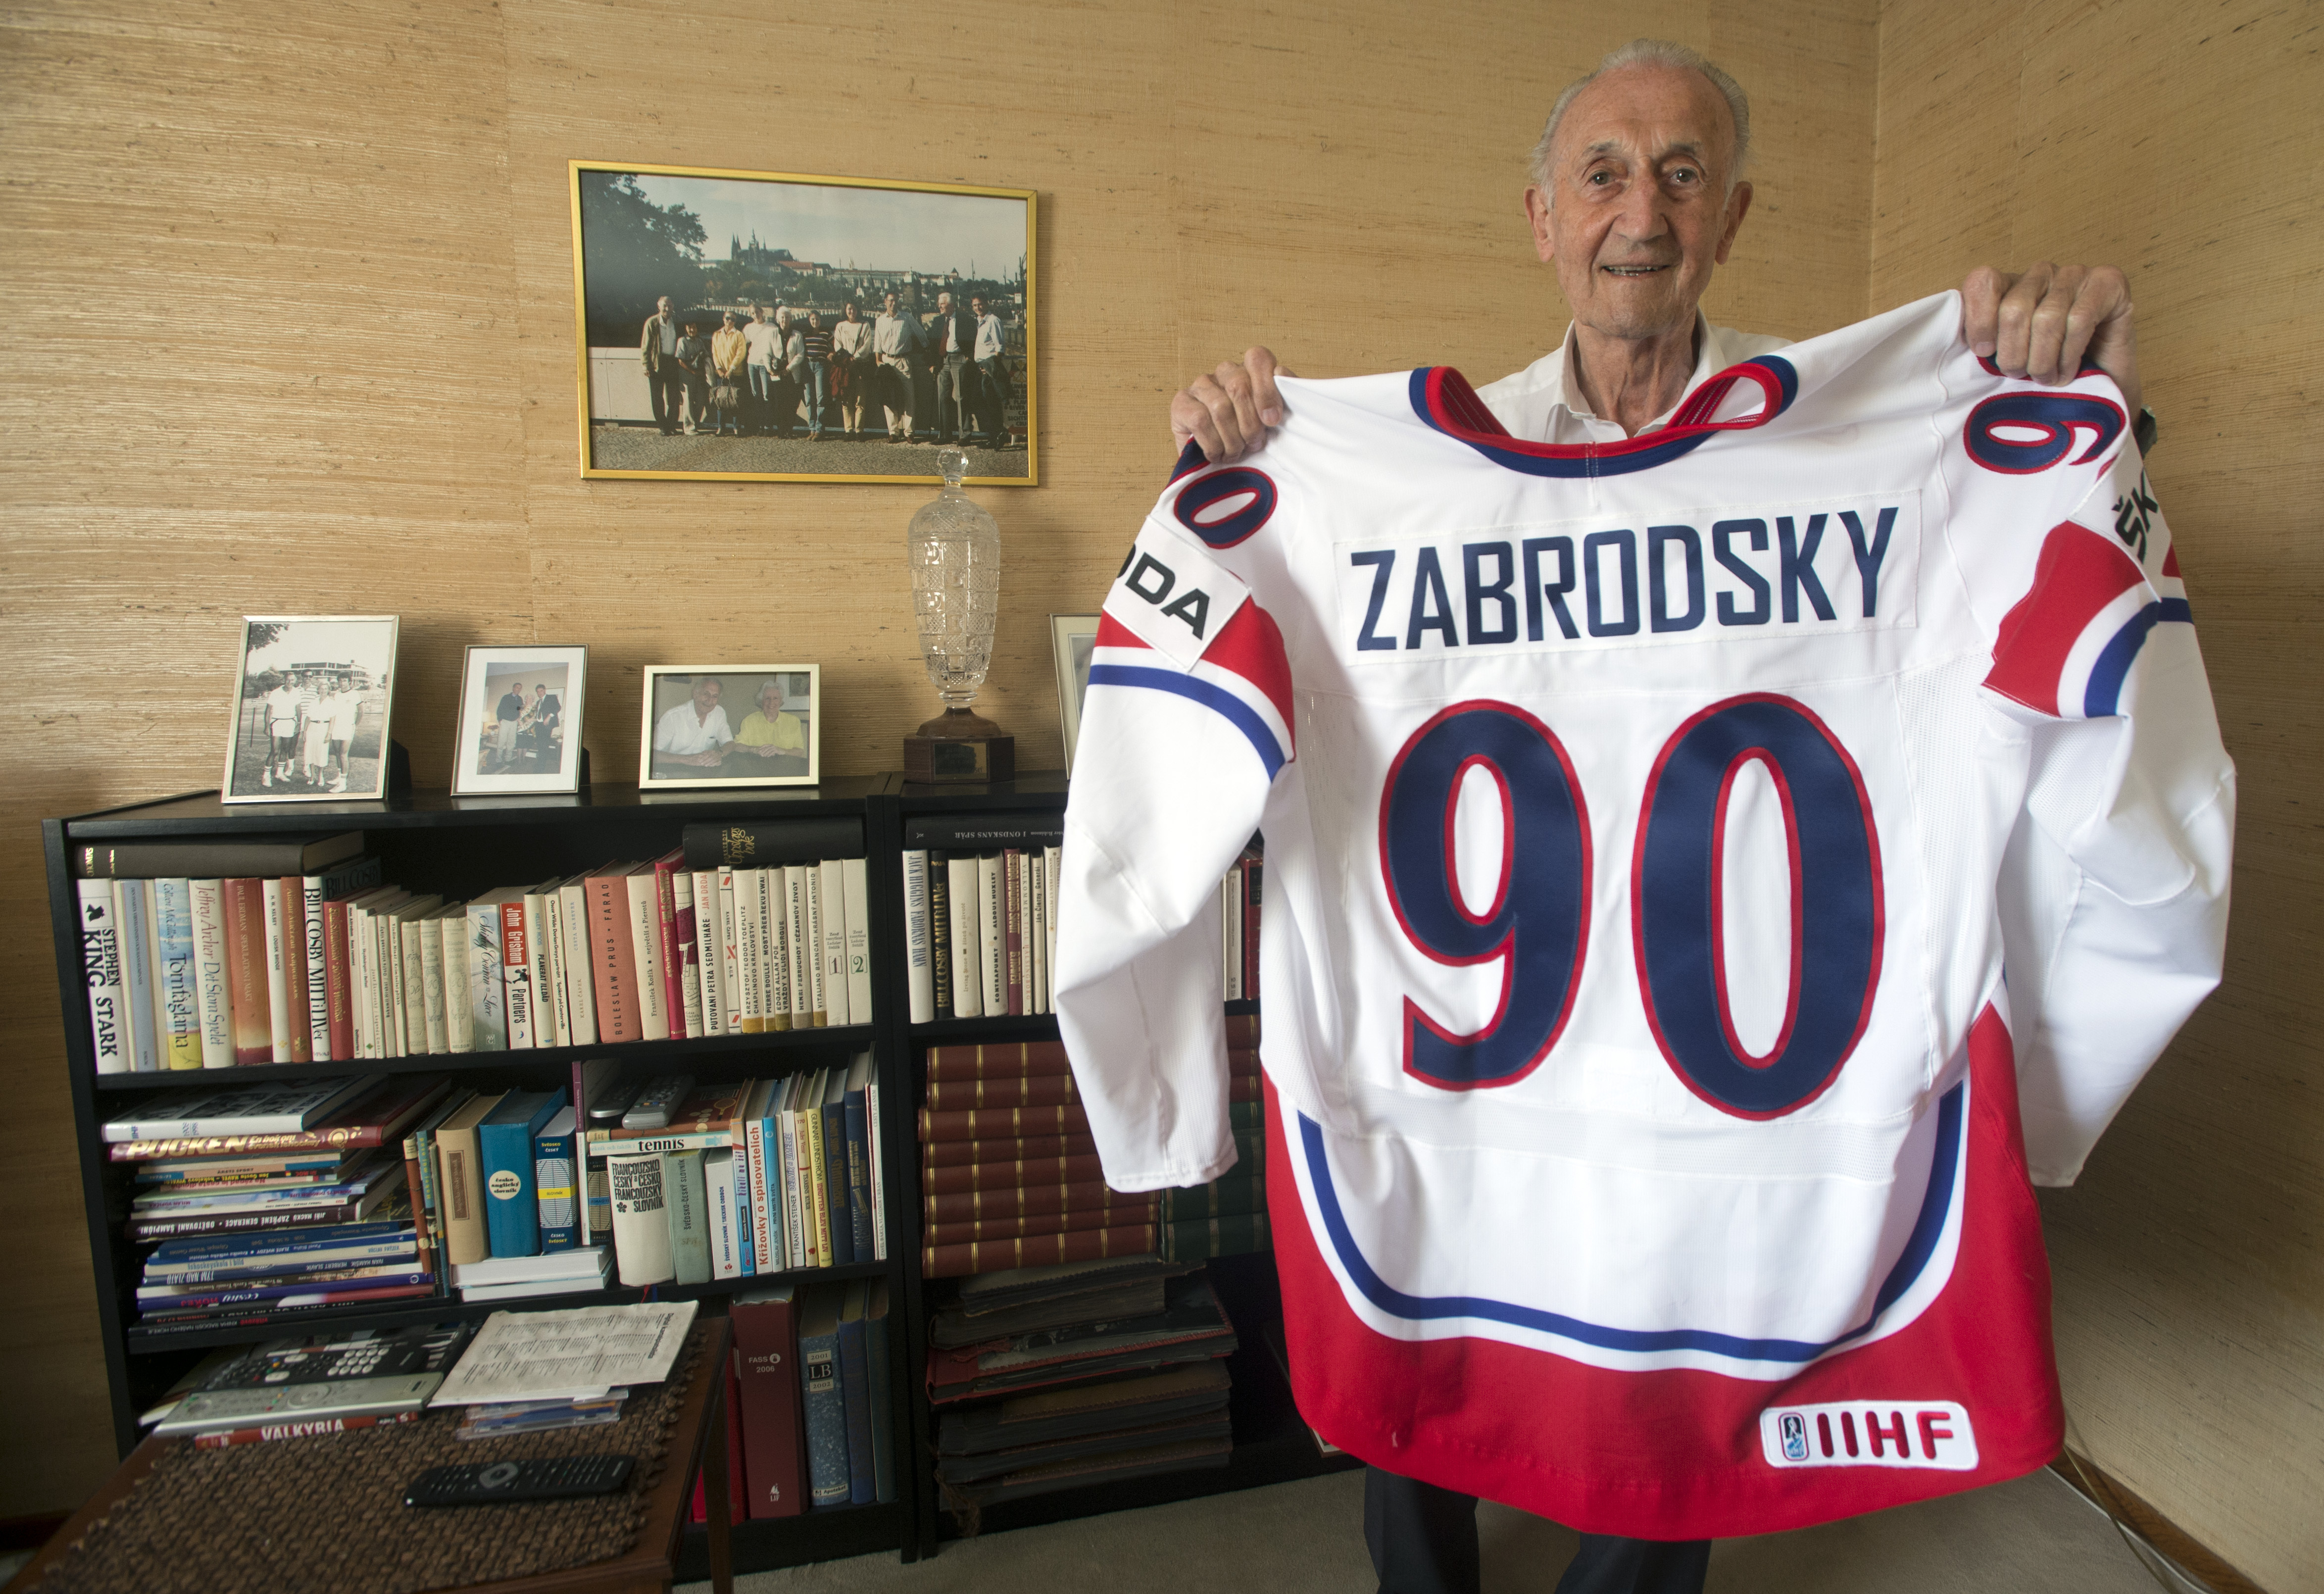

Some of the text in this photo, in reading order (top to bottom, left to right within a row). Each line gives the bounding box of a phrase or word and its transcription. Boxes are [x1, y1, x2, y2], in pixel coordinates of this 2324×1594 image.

[1350, 507, 1899, 651] ZABRODSKY
[700, 875, 708, 894] DRDA
[1007, 854, 1019, 912] SIERRA MADRES
[237, 886, 247, 931] PAUL ERDMAN
[304, 888, 324, 963] BILL COSBY
[908, 856, 927, 967] JACK HIGGINS FARORNAS HAMN
[1379, 692, 1885, 1121] 90
[195, 885, 226, 1046] Jeffrey Archer Det Stora Spelet
[506, 908, 527, 1023] John Grisham Partners
[601, 884, 622, 1034] BOLESLAW PRUS FARAO
[702, 919, 713, 966] SEDMILHÁŘE
[163, 884, 191, 1048] Colleen Törnfåglarna
[474, 916, 498, 1017] Shirley Conran Lace
[538, 954, 546, 981] PLANERAT
[935, 946, 949, 1007] BILL COSBY
[82, 929, 120, 1057] STEPHEN KING STARK
[541, 983, 549, 1002] ILLDÅD
[708, 996, 718, 1030] PUTOVÁNÍ
[126, 1136, 249, 1159] PUCKEN
[612, 1159, 660, 1175] FRANCOUZSKO
[638, 1139, 684, 1151] tennis
[750, 1127, 765, 1201] spisovatelích
[813, 1143, 823, 1181] LUNDSTRÖM
[613, 1172, 661, 1188] ČESKÝ ČESKO
[615, 1183, 662, 1200] FRANCOUZSKÝ
[678, 1159, 691, 1230] ŠVÉDSKO-ČESKÝ SLOVNÍK
[225, 1217, 258, 1227] GENERACE
[261, 1215, 290, 1226] ZAPŘENÉ
[634, 1196, 664, 1212] SLOVNÍK
[757, 1217, 768, 1265] Křížovky
[810, 1364, 831, 1379] LB
[260, 1419, 345, 1441] VALKYRIA
[1817, 1411, 1953, 1459] IIHF
[824, 1485, 846, 1494] Apoteket
